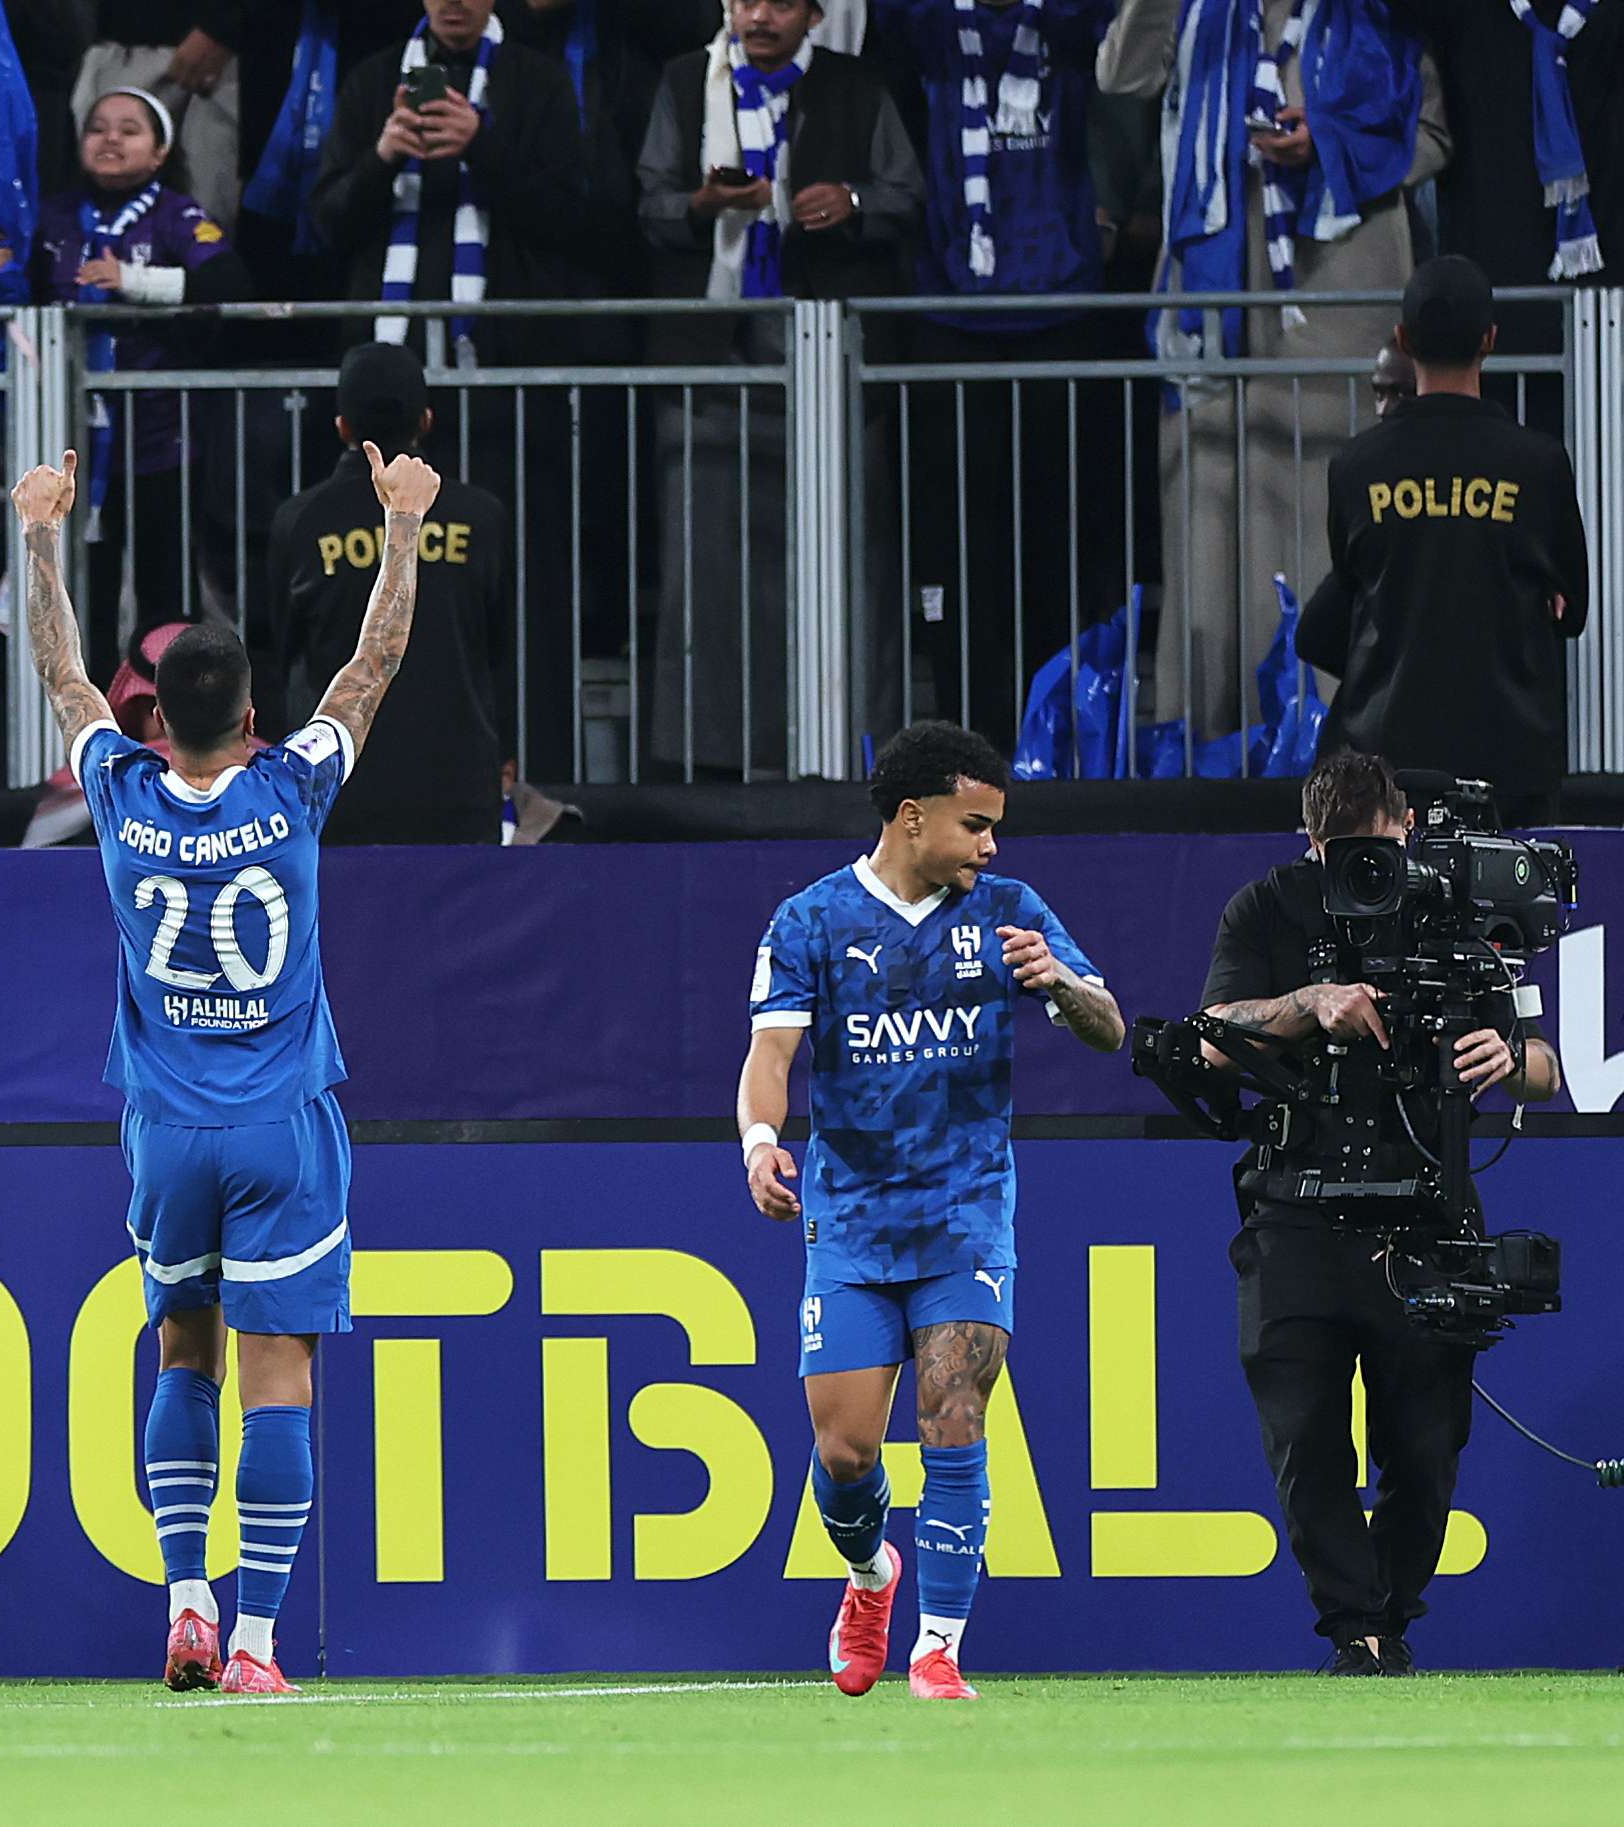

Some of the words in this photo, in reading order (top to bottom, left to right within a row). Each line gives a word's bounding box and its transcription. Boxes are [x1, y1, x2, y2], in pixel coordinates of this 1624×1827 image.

[1368, 476, 1520, 523] POLICE
[318, 521, 471, 576] POCE
[118, 817, 173, 858] JOÃO
[179, 812, 289, 866] CANCELO
[134, 866, 288, 992] 20
[191, 1017, 269, 1031] FOUNDATION
[192, 998, 269, 1019] ALHILAL
[847, 1005, 981, 1048] SAVVY
[852, 1050, 915, 1064] GAMES
[936, 1542, 976, 1555] HILAL
